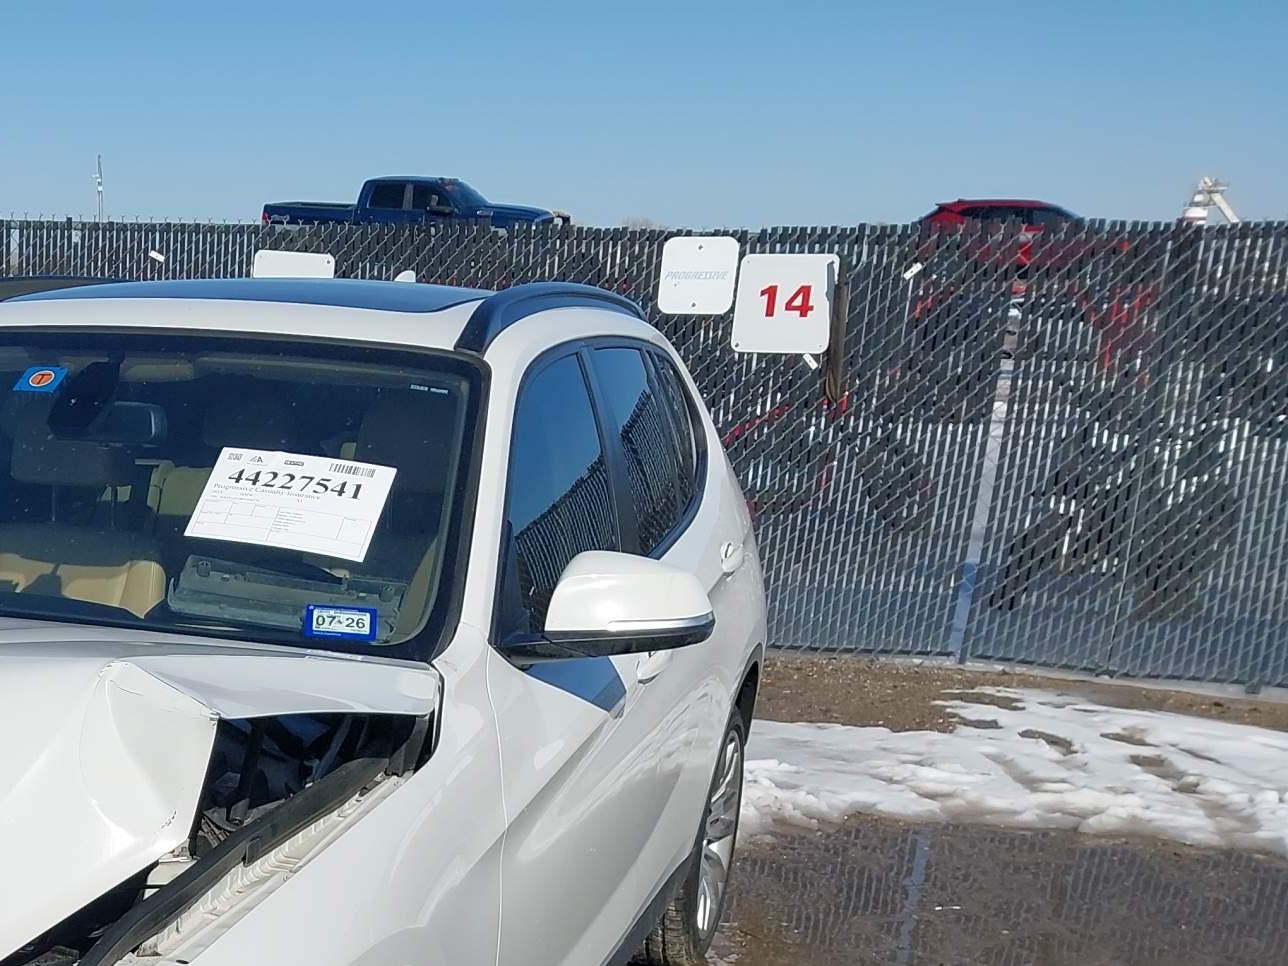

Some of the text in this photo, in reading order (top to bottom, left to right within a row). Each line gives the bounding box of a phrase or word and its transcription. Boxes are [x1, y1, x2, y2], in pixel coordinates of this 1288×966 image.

[664, 271, 729, 281] PROGRESSIVE
[759, 284, 815, 318] 14
[227, 468, 364, 501] 44227541
